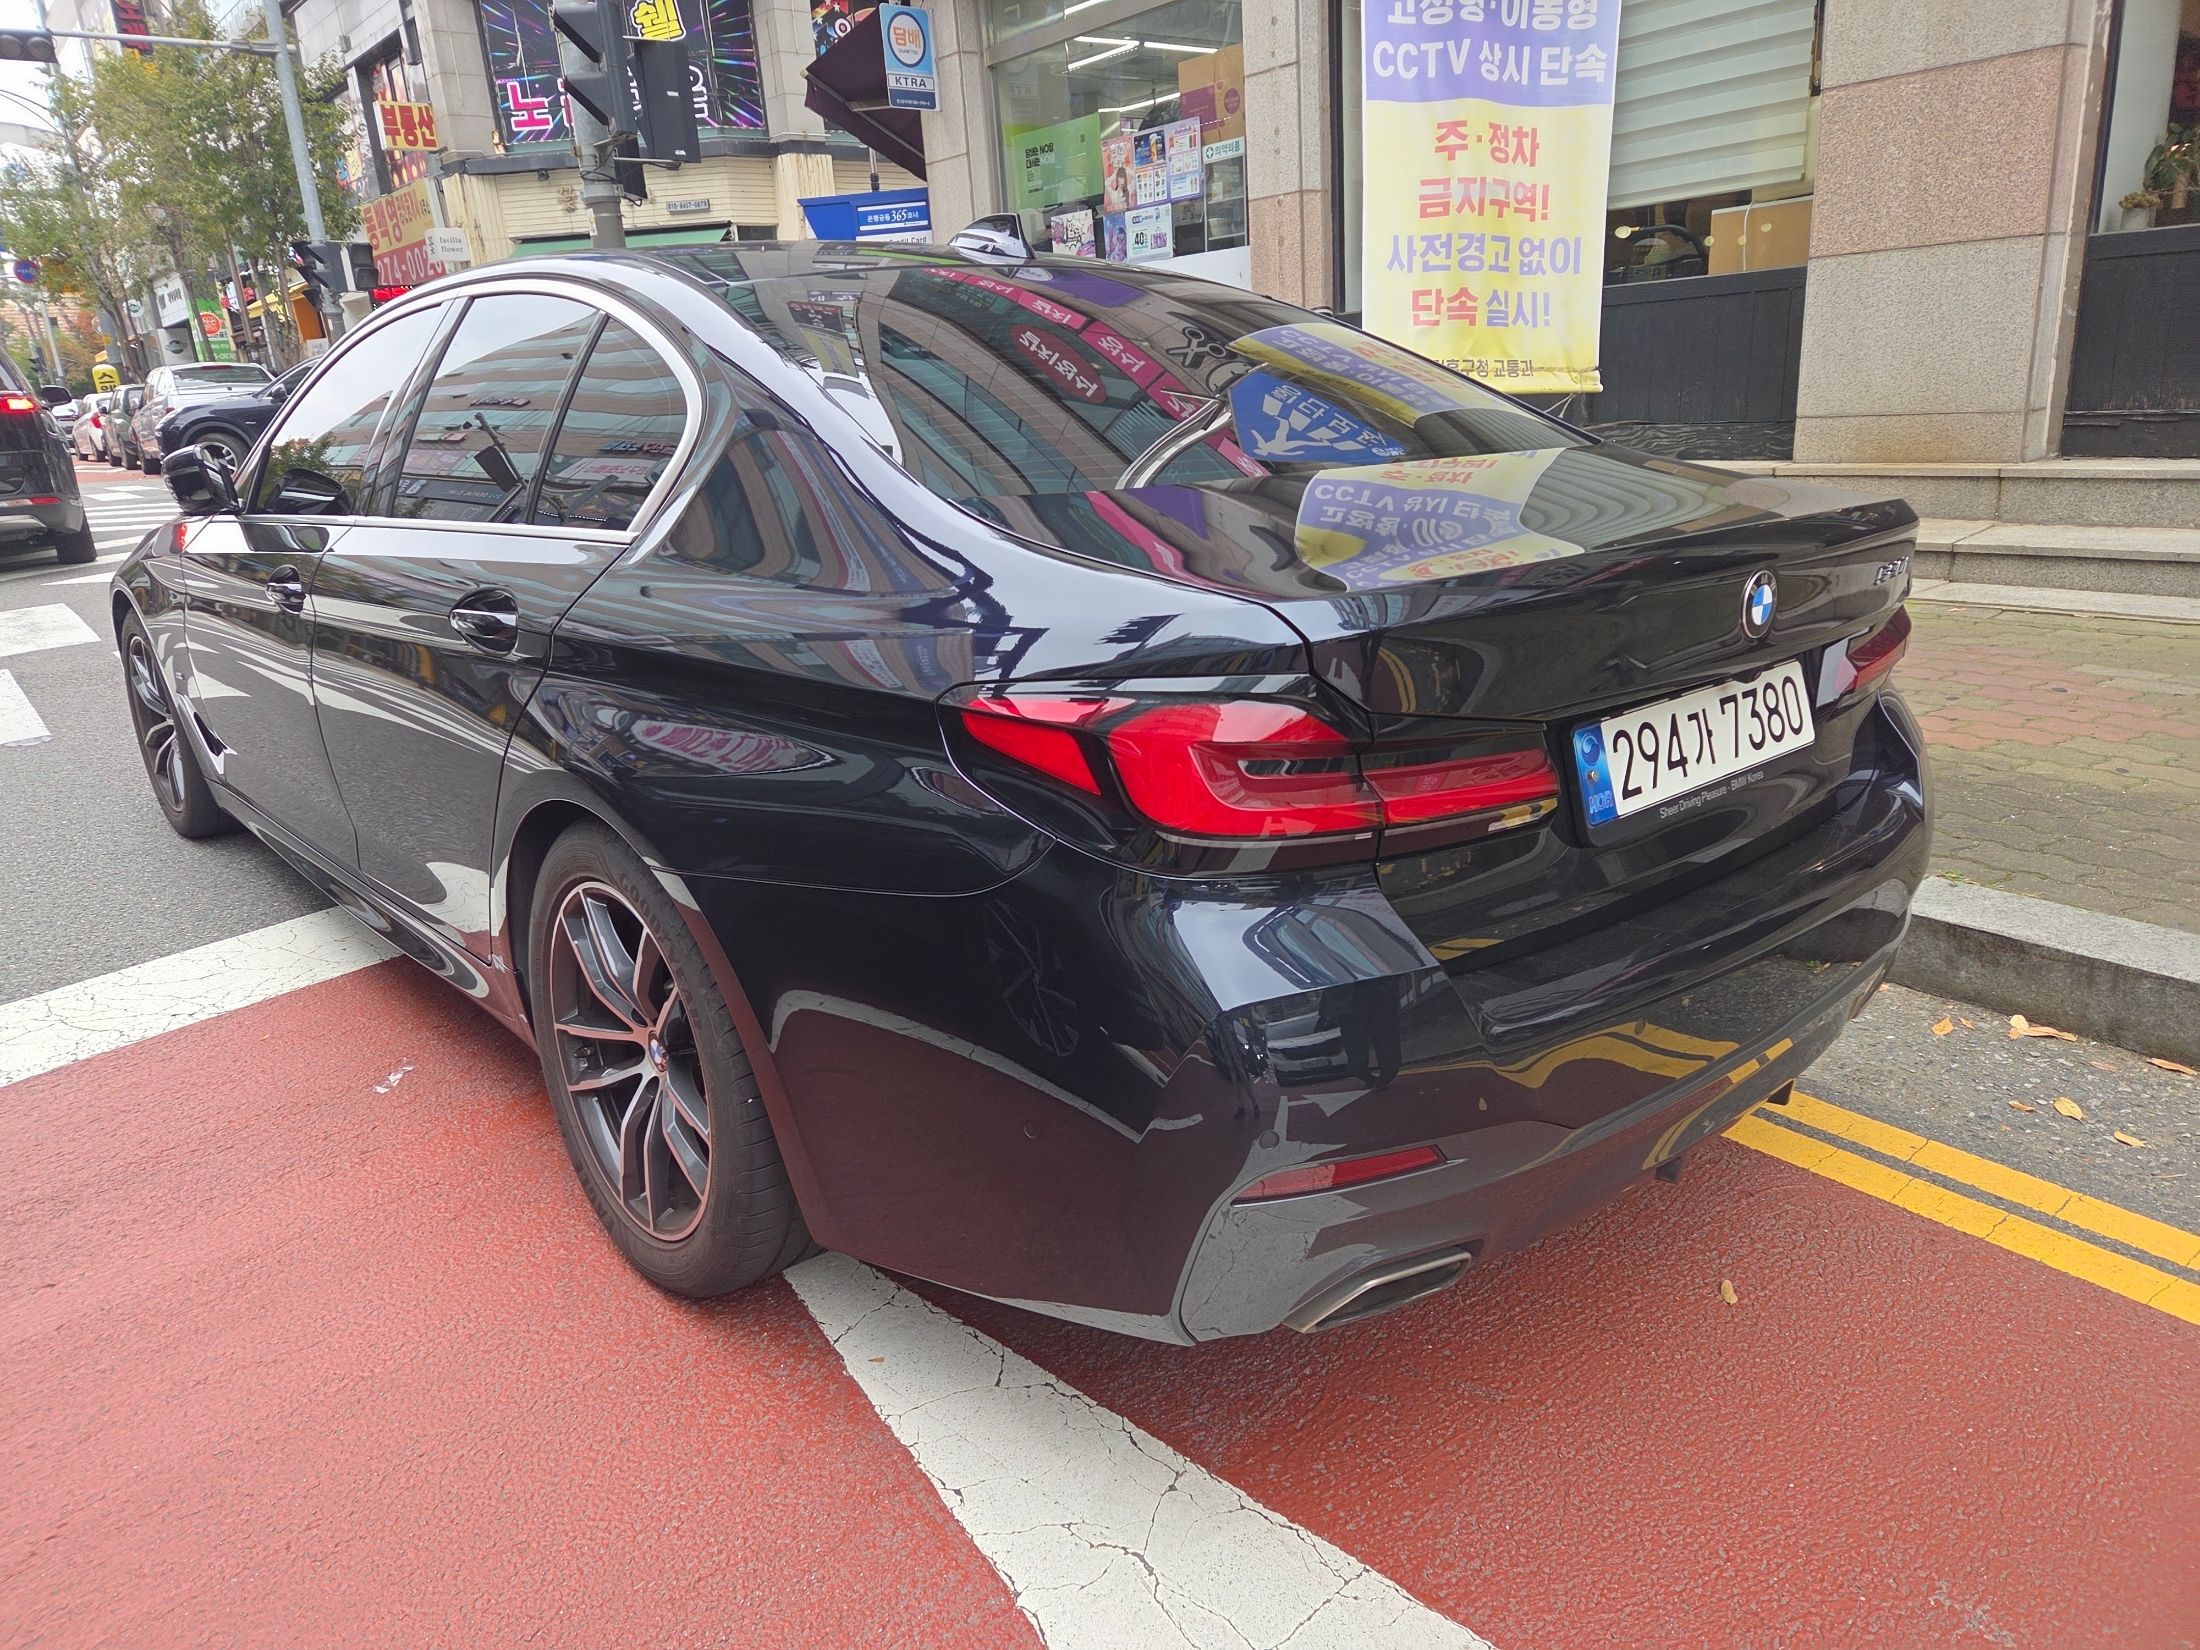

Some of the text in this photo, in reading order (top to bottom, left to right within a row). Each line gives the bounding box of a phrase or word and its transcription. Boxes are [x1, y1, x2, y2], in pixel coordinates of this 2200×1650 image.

[893, 26, 921, 49] 담배
[1373, 38, 1607, 86] CCTV 상시 단속
[895, 76, 927, 88] KTRA
[380, 104, 437, 147] 부동산
[1418, 176, 1551, 221] 금지구역!
[441, 245, 464, 253] flower
[1411, 287, 1551, 328] 단속 실시!
[1493, 360, 1534, 377] 교통과
[1588, 790, 1614, 814] KOR
[1659, 770, 1764, 819] Sheer Driving Pleasure BMW Korea
